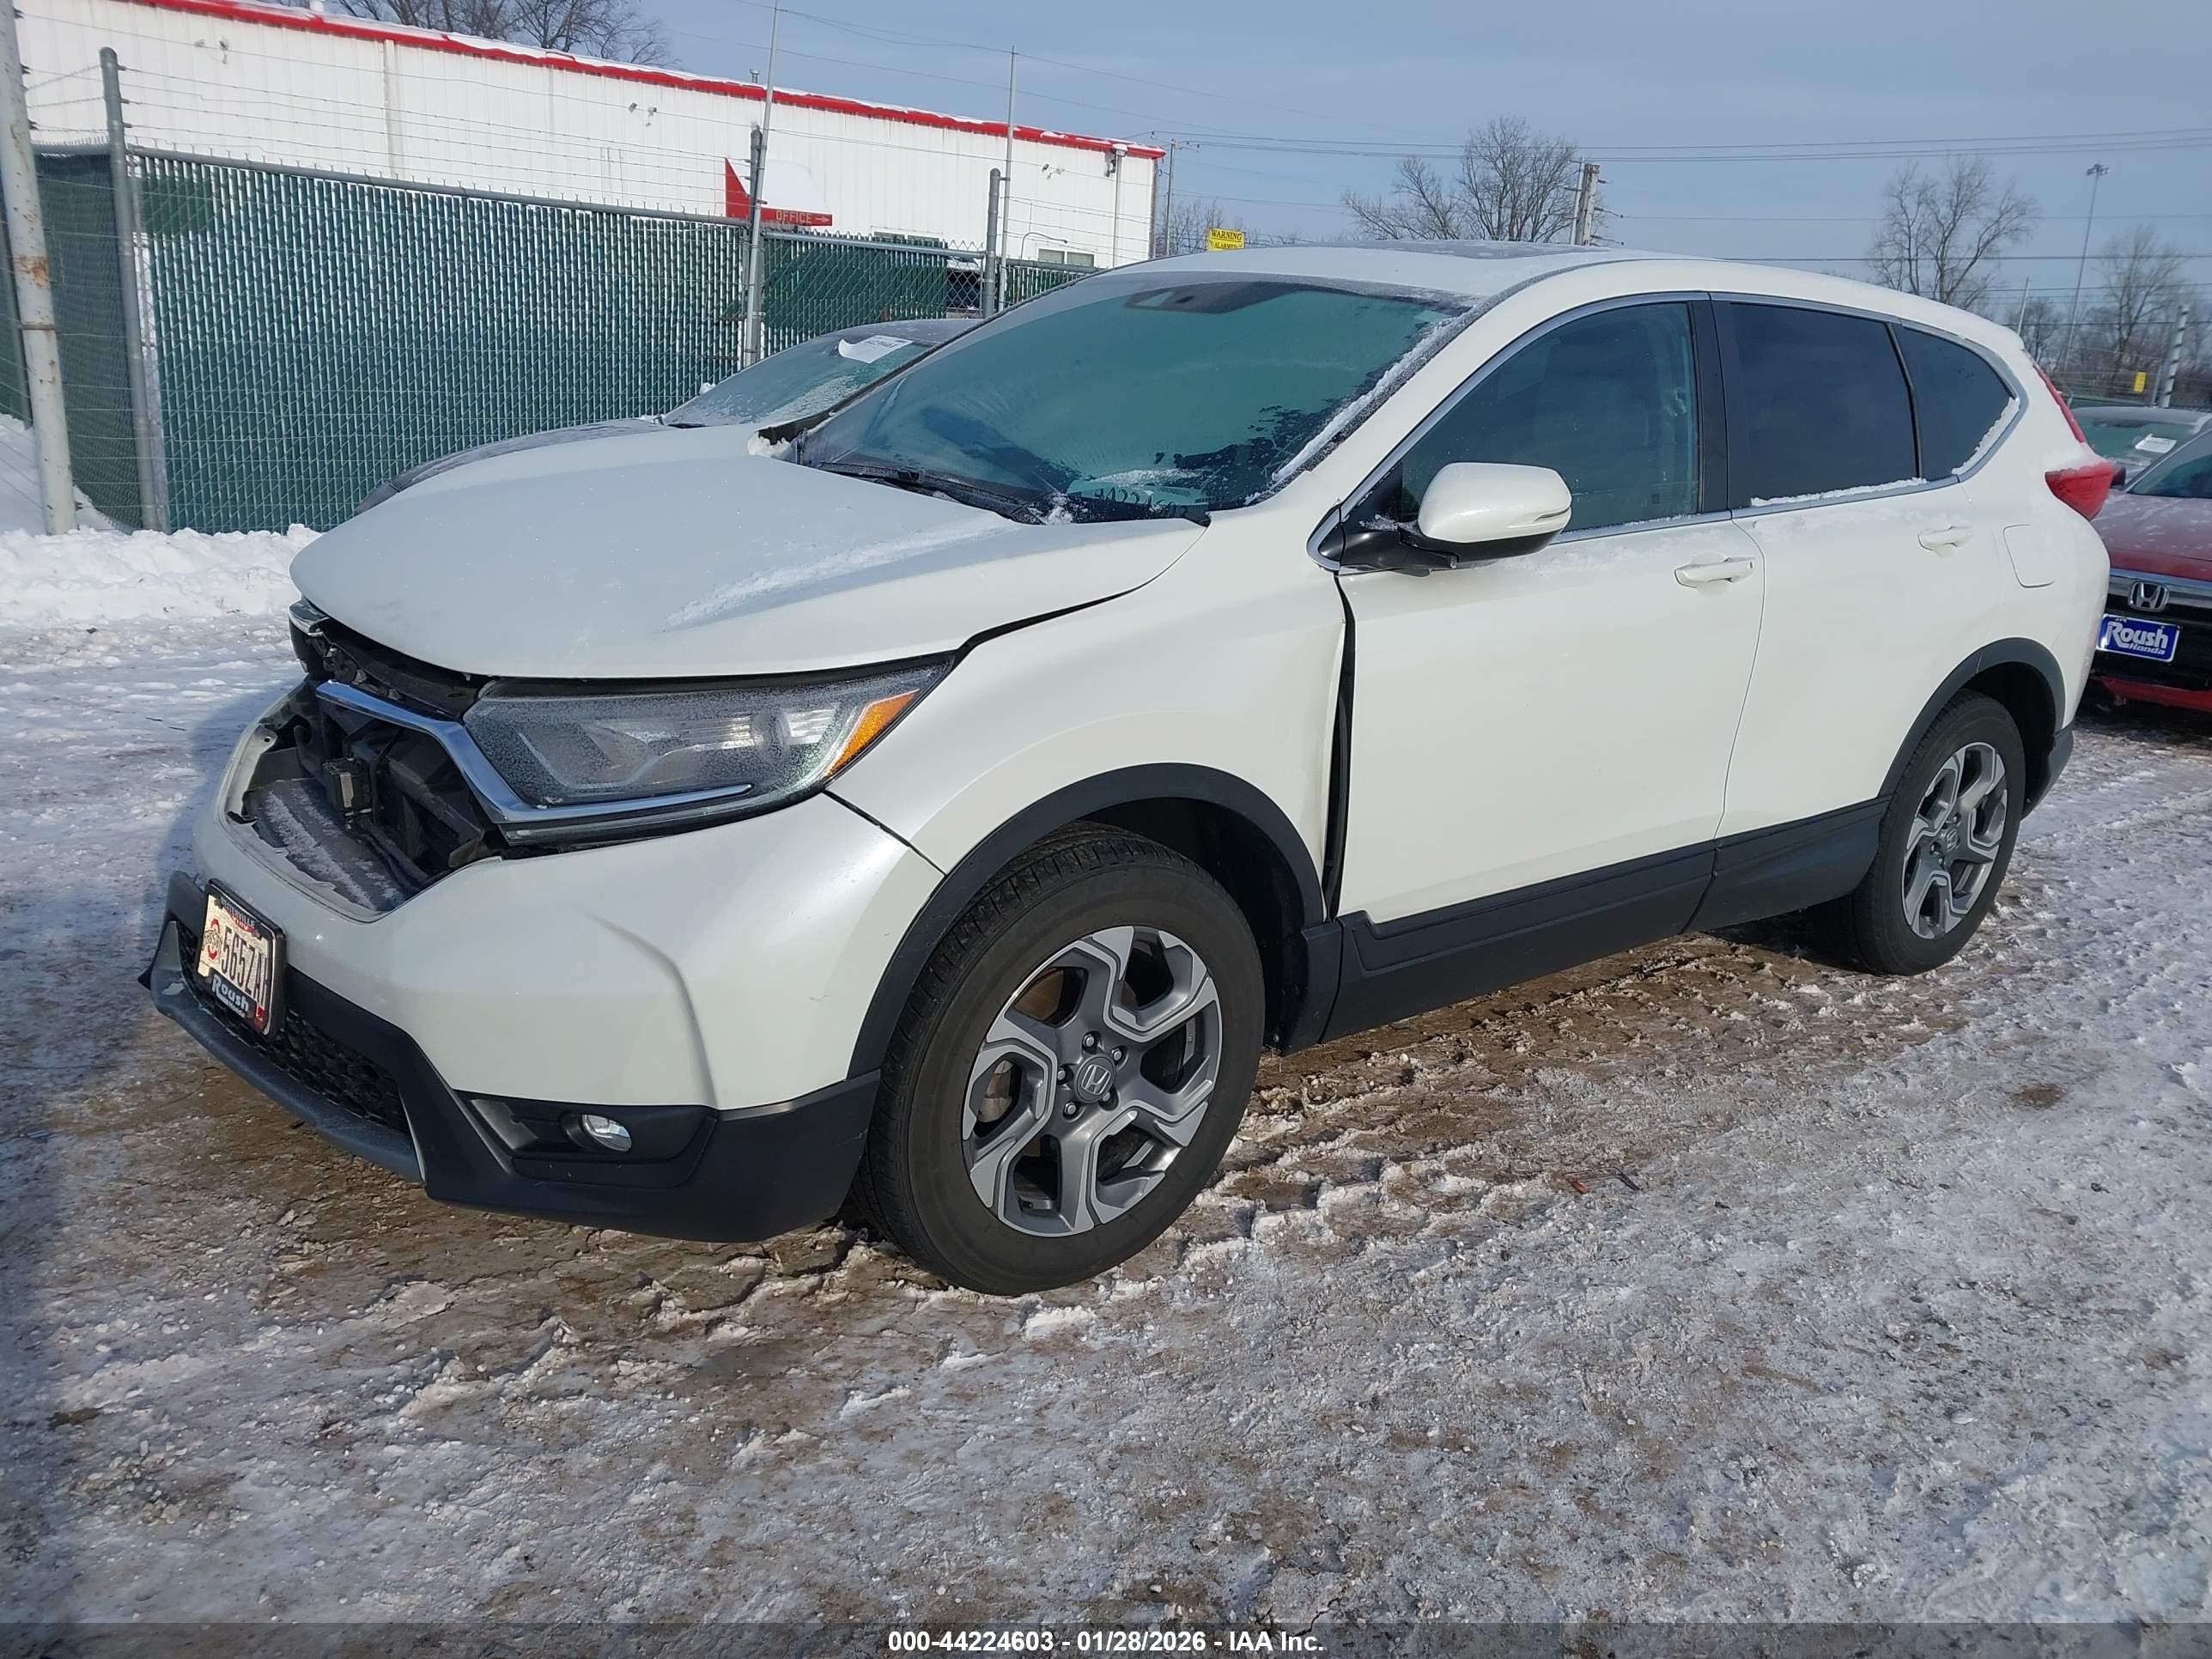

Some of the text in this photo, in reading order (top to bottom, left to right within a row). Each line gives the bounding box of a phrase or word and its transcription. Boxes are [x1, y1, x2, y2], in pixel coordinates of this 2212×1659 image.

[775, 210, 811, 223] OFFICE
[1211, 229, 1243, 241] WARNING
[2106, 621, 2169, 648] Roush
[2130, 643, 2166, 655] Honda
[211, 973, 249, 1012] Roush
